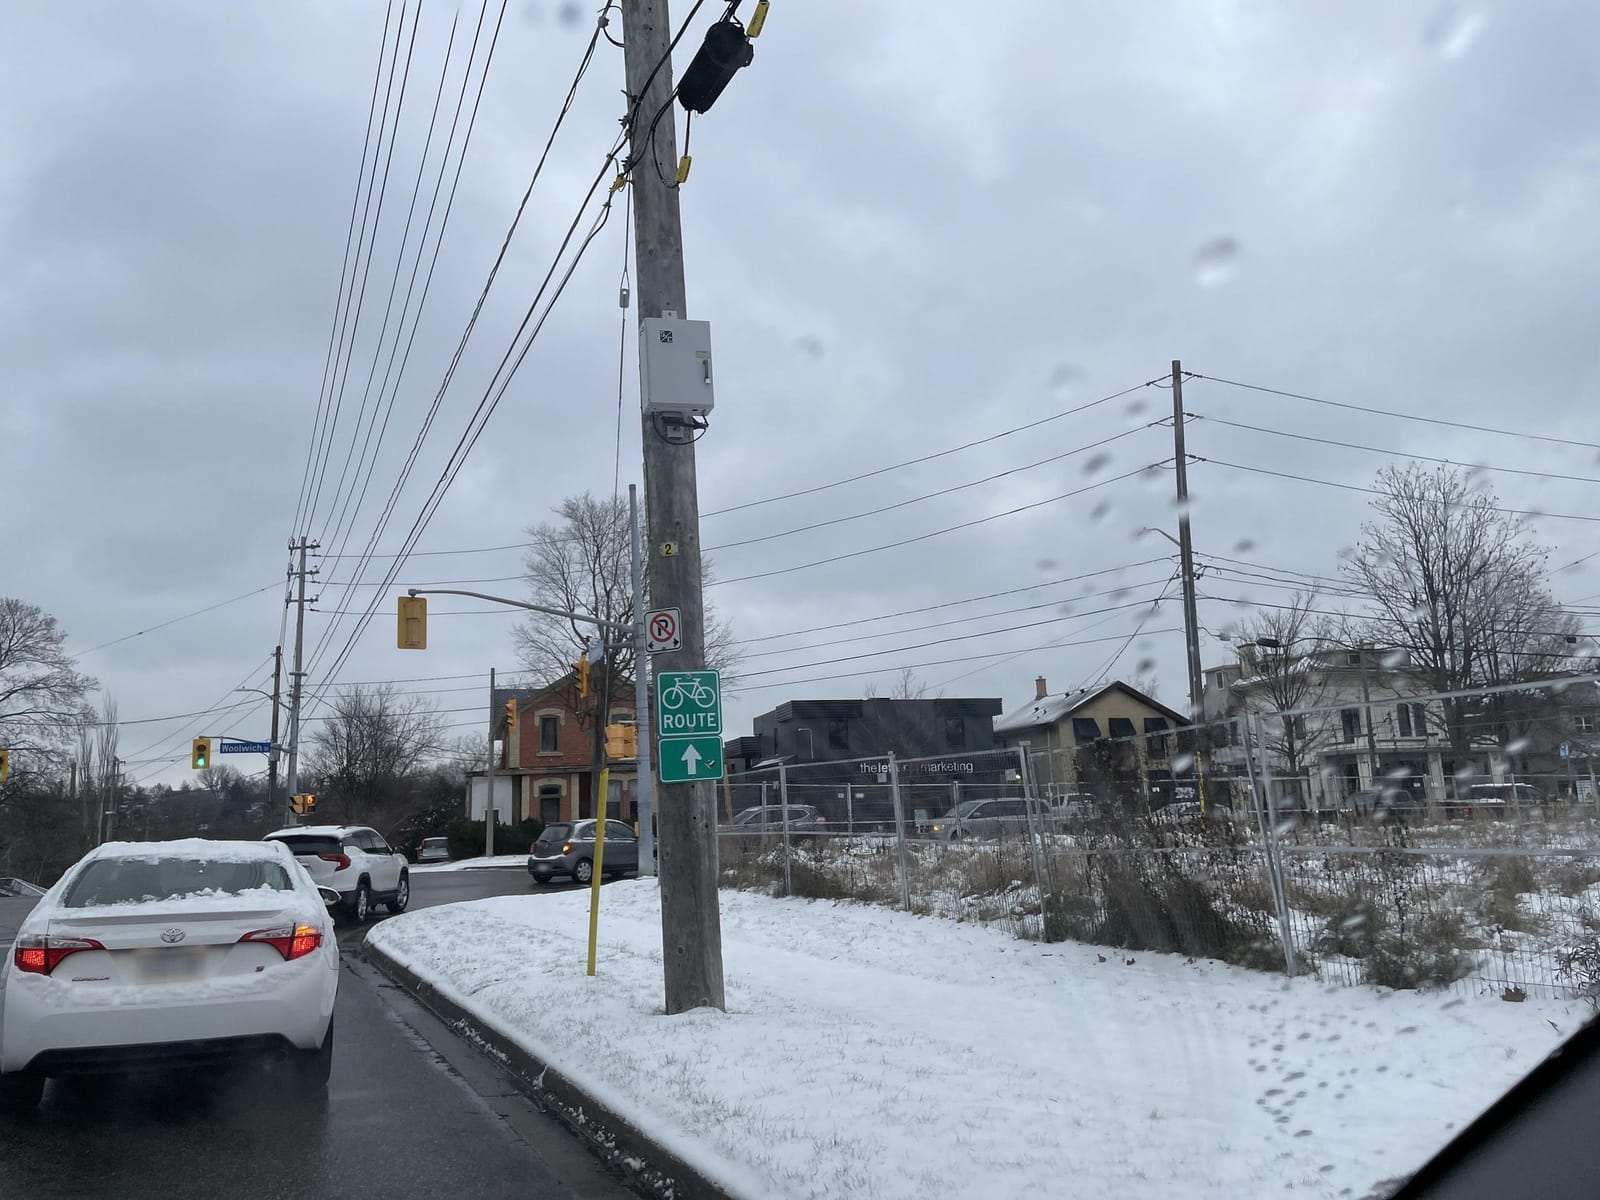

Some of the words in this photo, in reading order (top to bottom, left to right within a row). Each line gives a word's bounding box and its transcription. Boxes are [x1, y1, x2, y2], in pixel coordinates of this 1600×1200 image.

[665, 543, 672, 555] 2
[663, 713, 717, 729] ROUTE
[221, 743, 262, 752] Woolwich
